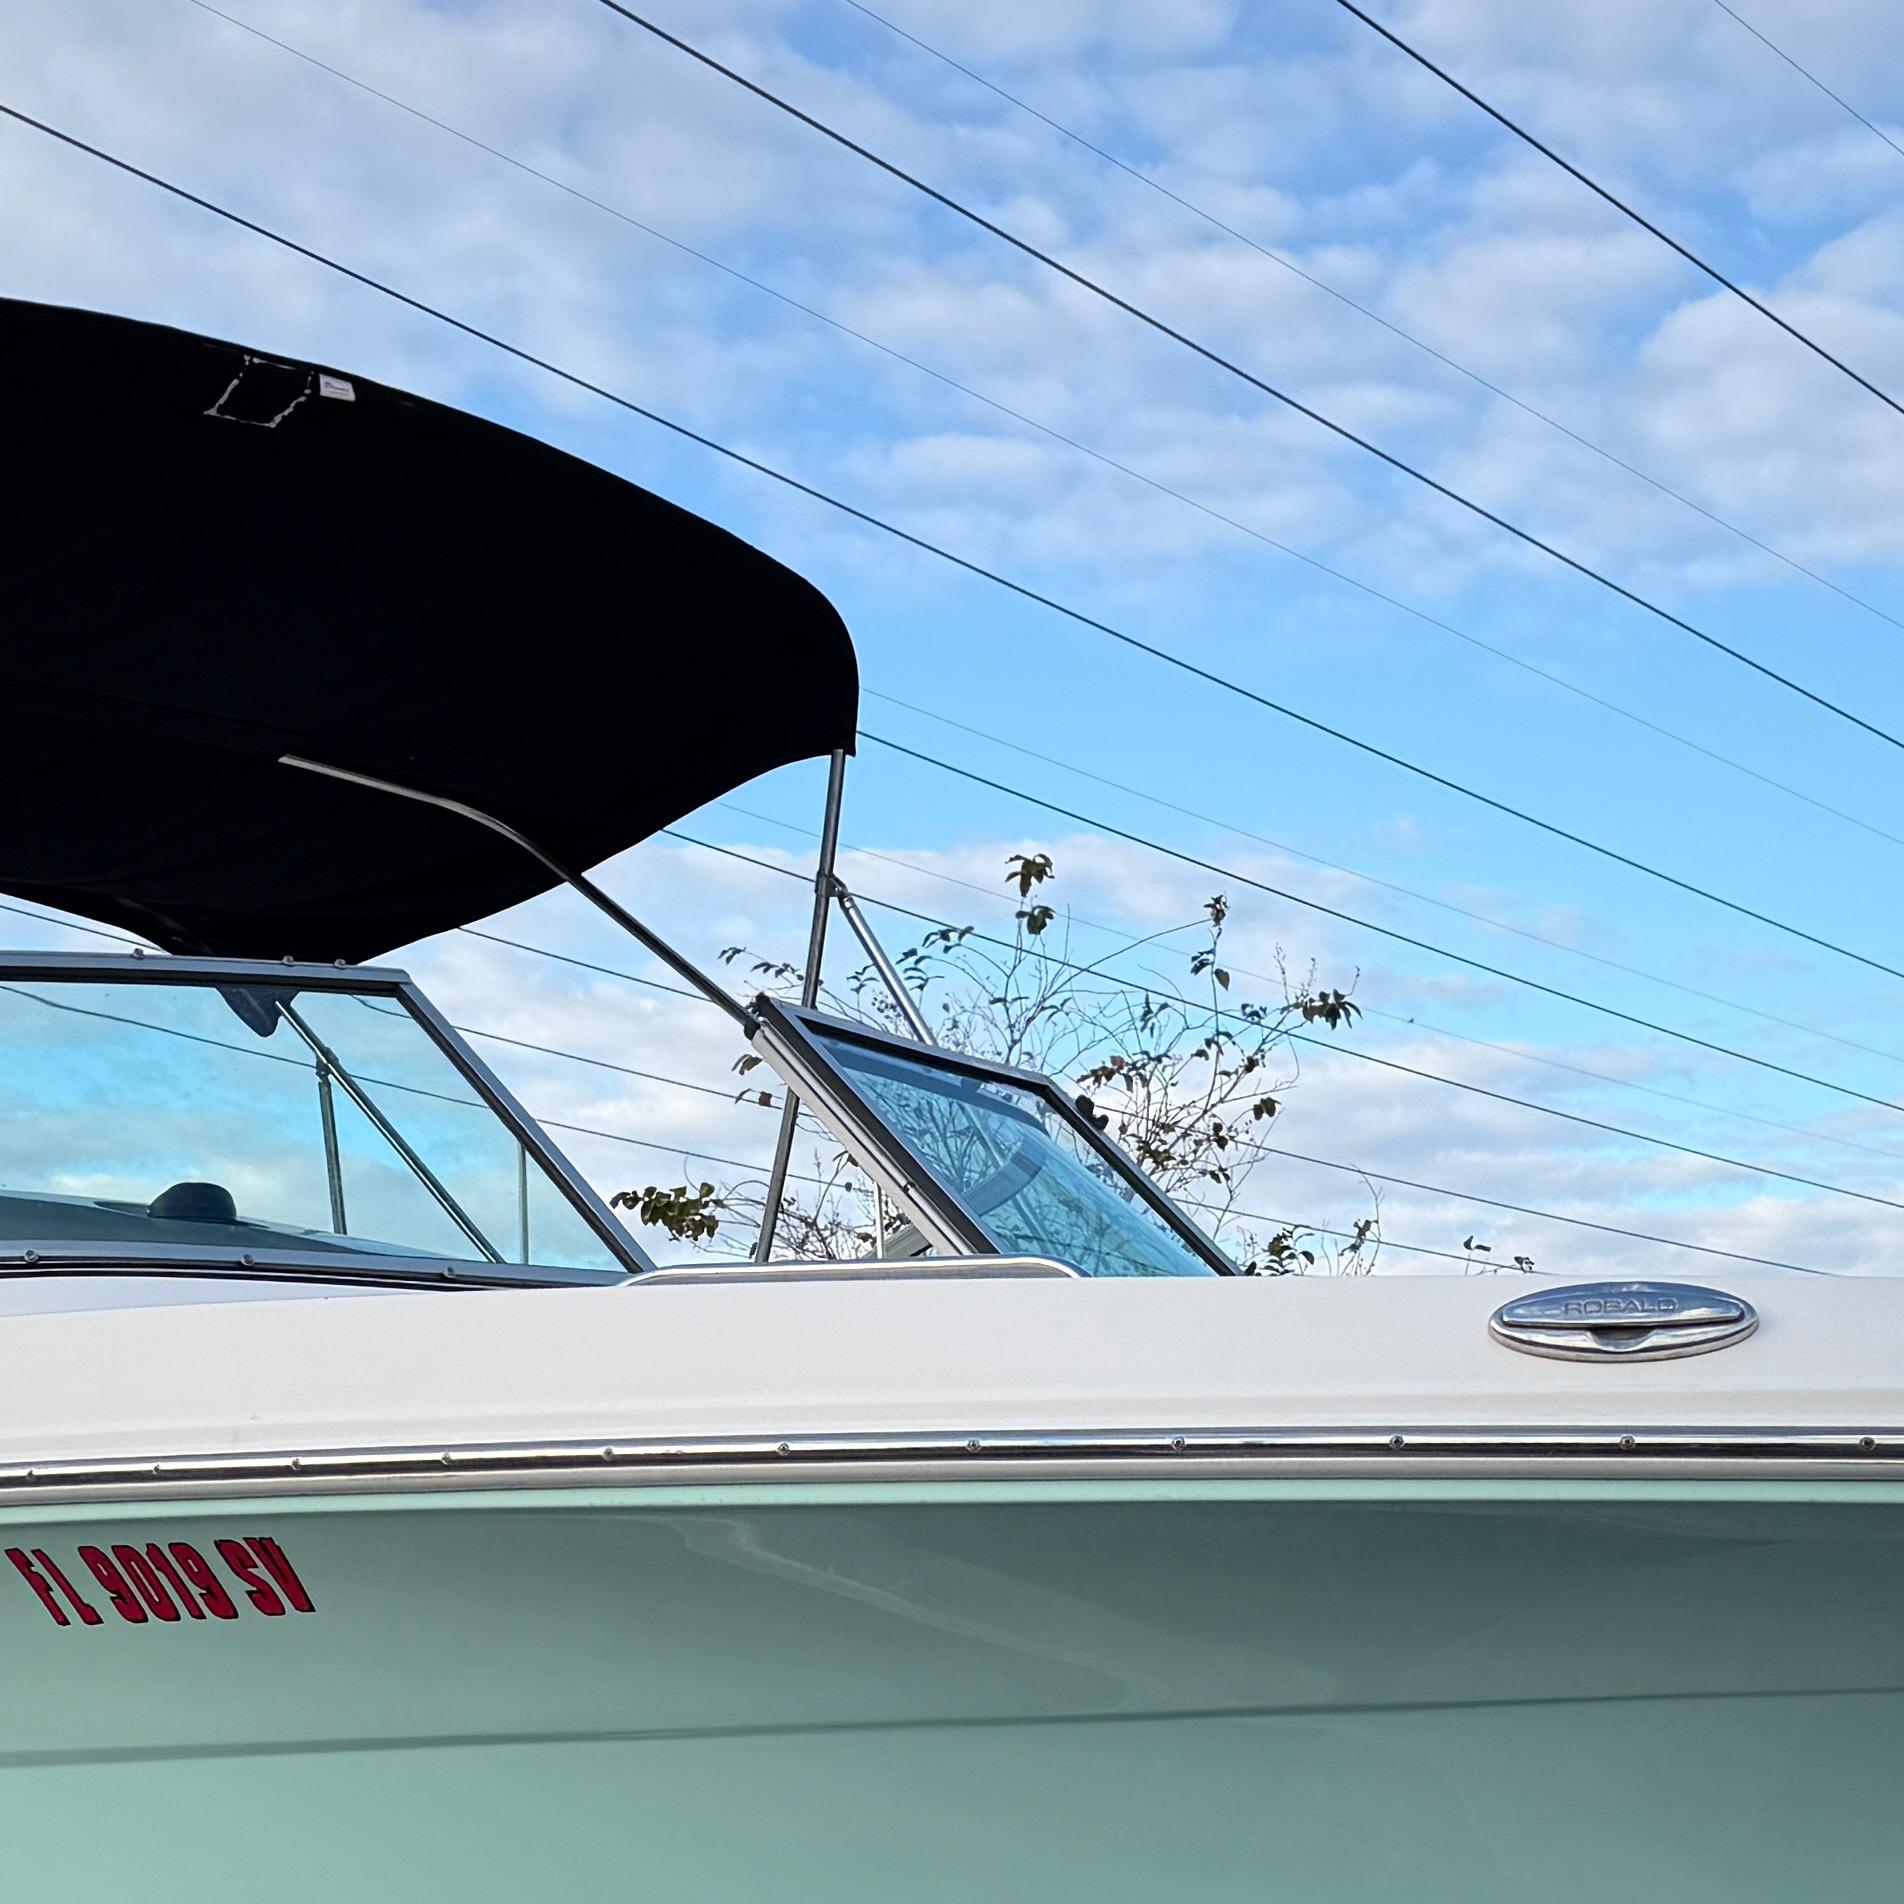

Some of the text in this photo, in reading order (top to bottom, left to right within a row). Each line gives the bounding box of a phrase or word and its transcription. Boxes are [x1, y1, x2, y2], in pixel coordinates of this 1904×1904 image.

[1564, 1297, 1680, 1316] ROBALO
[4, 1547, 104, 1627] FL
[77, 1542, 239, 1624] 9019
